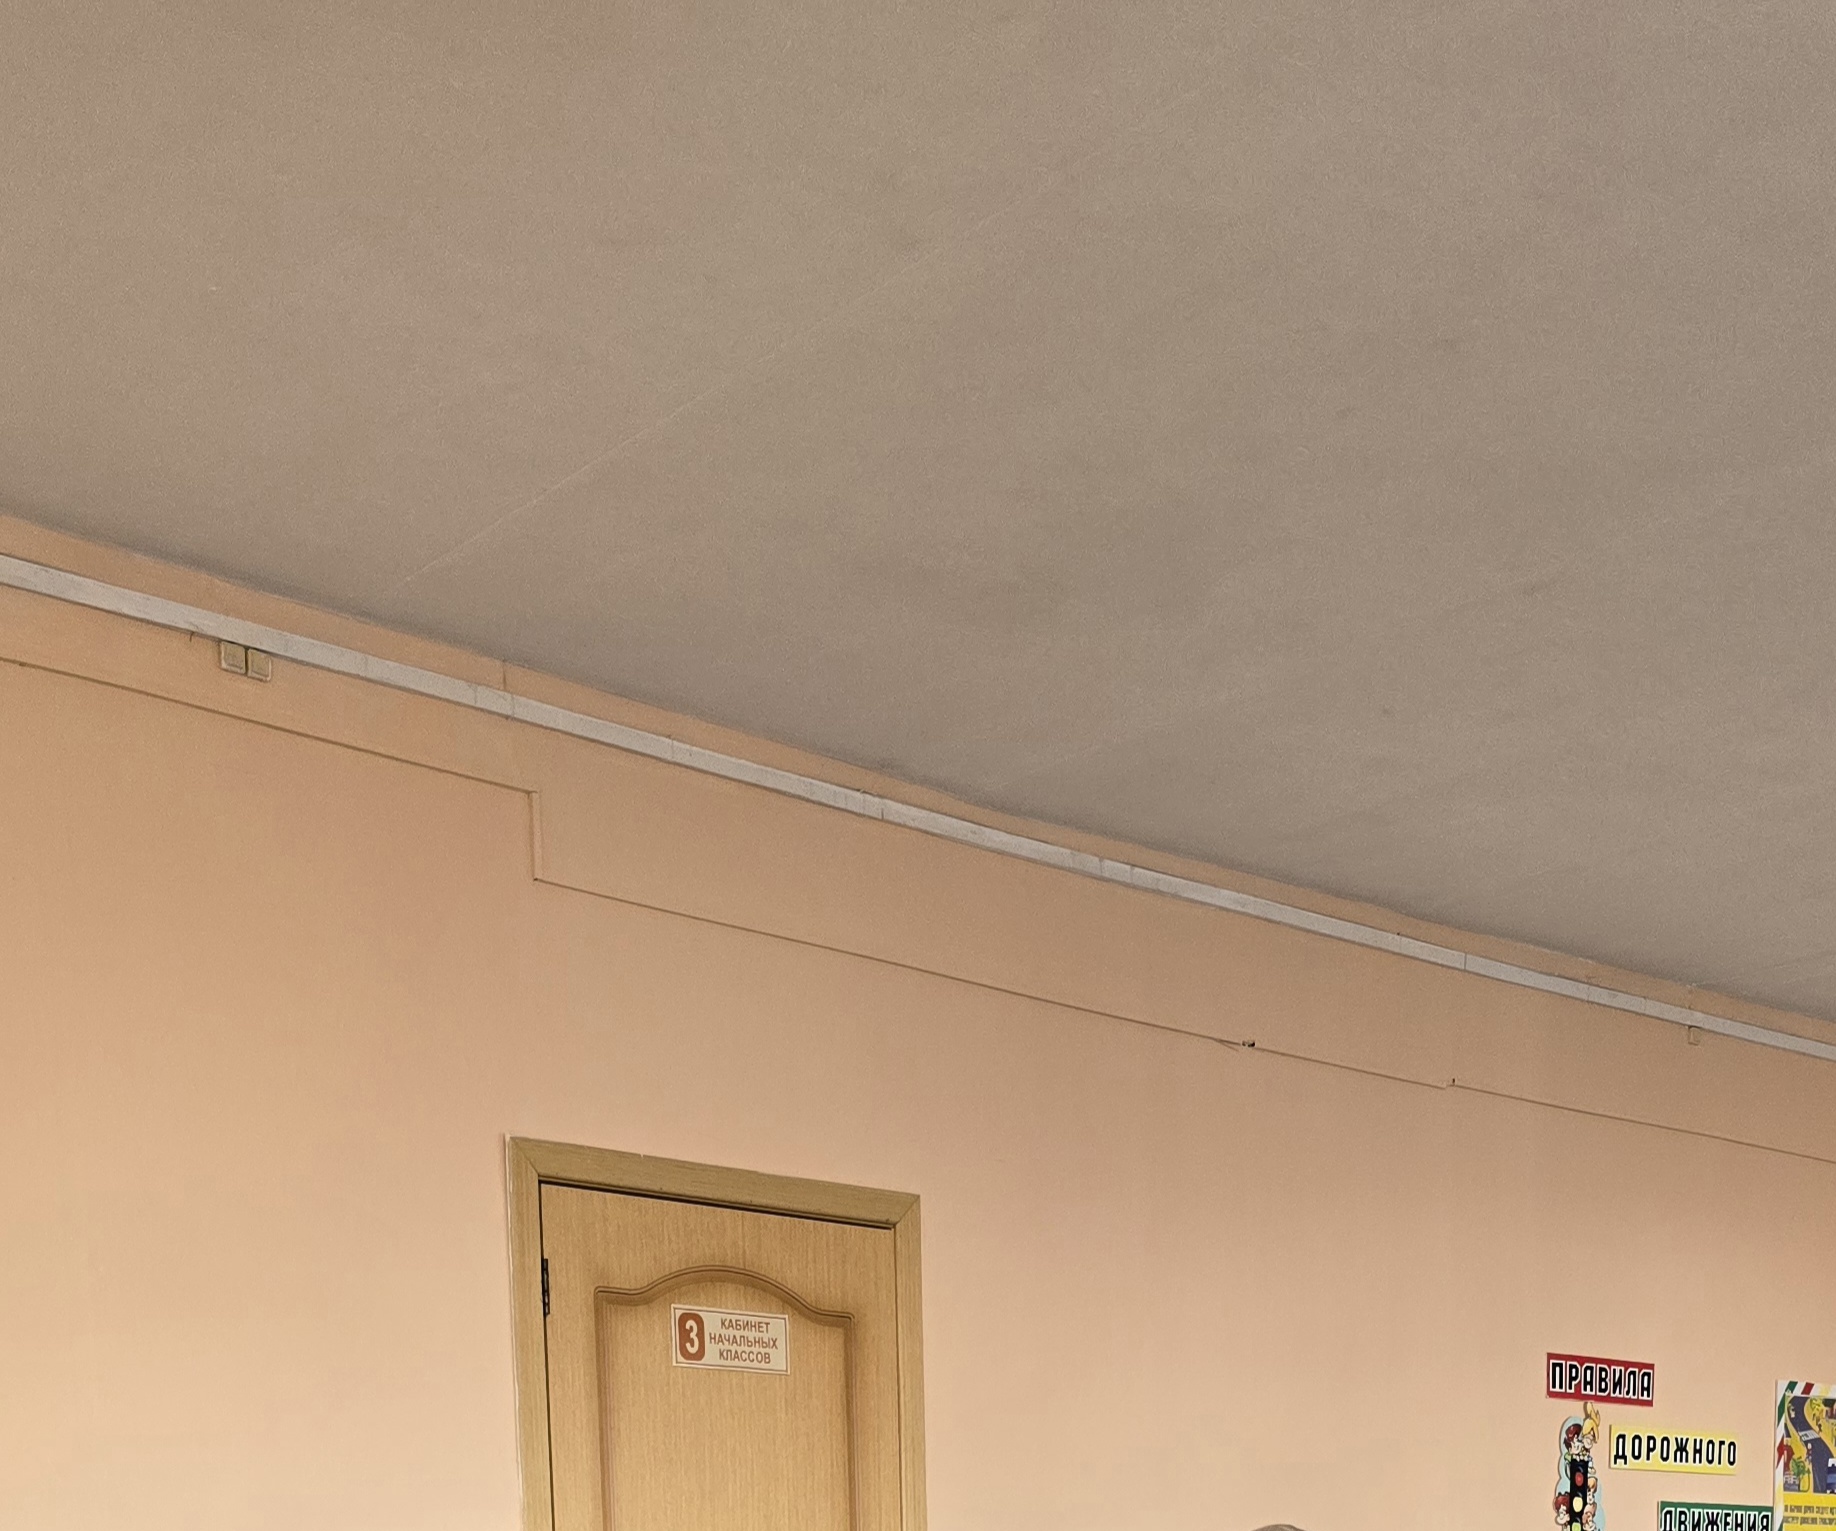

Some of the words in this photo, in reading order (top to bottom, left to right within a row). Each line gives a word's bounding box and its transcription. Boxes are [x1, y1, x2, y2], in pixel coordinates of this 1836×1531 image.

[685, 1319, 700, 1354] 3
[720, 1317, 770, 1334] КАБИНЕТ
[708, 1332, 778, 1350] НАЧАЛЬНЫХ
[718, 1348, 771, 1364] КЛАССОВ
[1550, 1361, 1653, 1399] ПРАВИЛА
[1613, 1433, 1737, 1467] ДОРОЖНОГО
